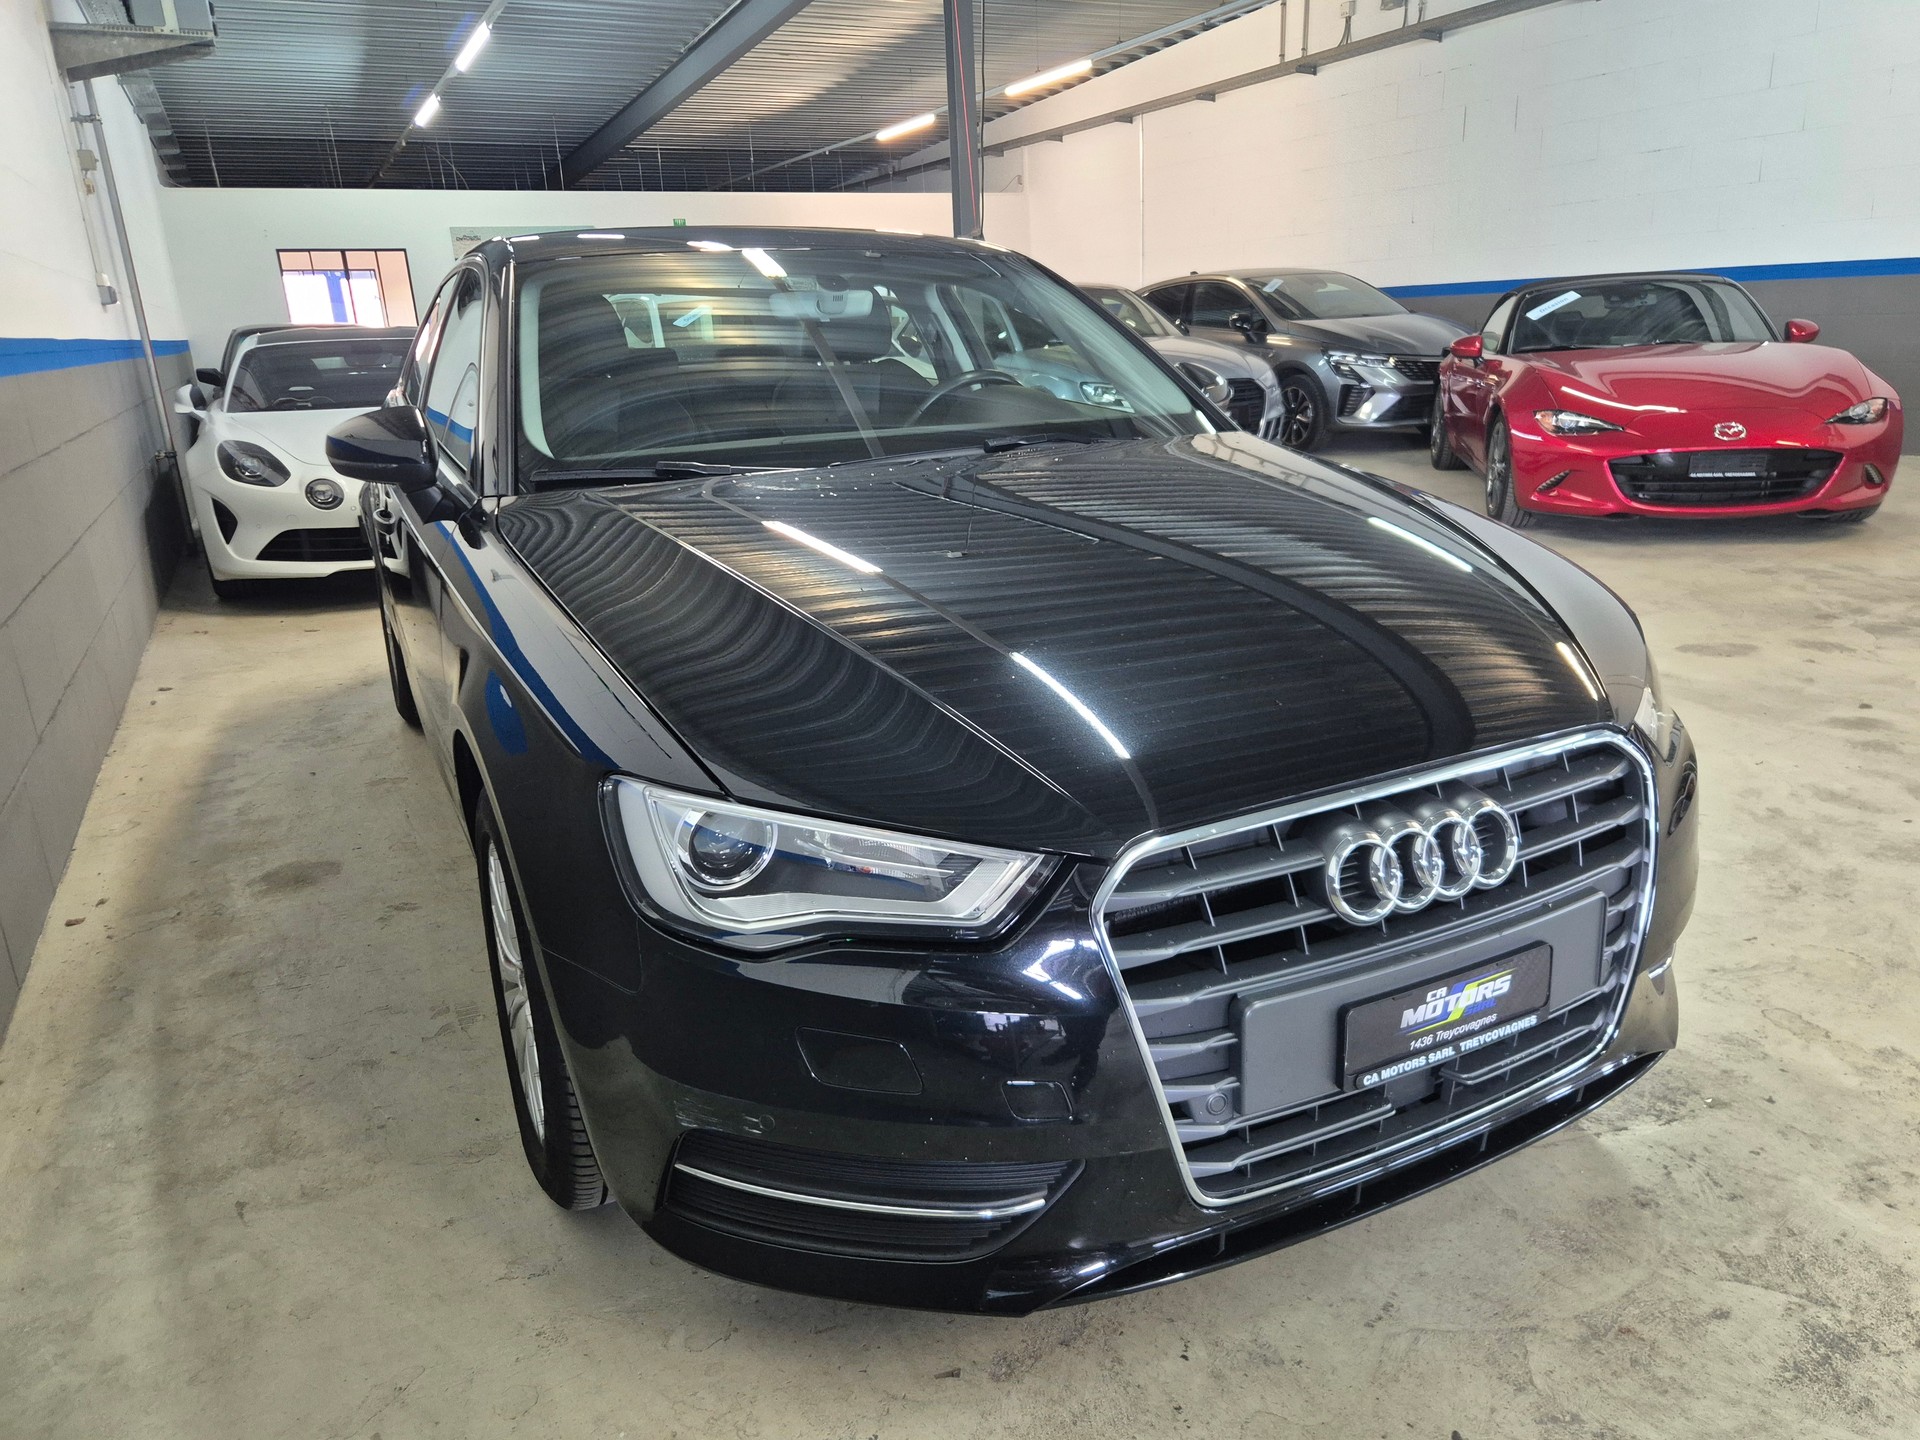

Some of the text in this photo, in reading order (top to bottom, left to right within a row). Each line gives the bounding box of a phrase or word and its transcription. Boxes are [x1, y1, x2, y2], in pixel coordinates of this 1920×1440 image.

[1400, 974, 1512, 1029] MOTORS
[1426, 986, 1448, 1003] CA
[1363, 1015, 1537, 1086] CA MOTORS SARL TREYCOVAGNES
[1409, 1013, 1498, 1051] 1436 Treycovagnes
